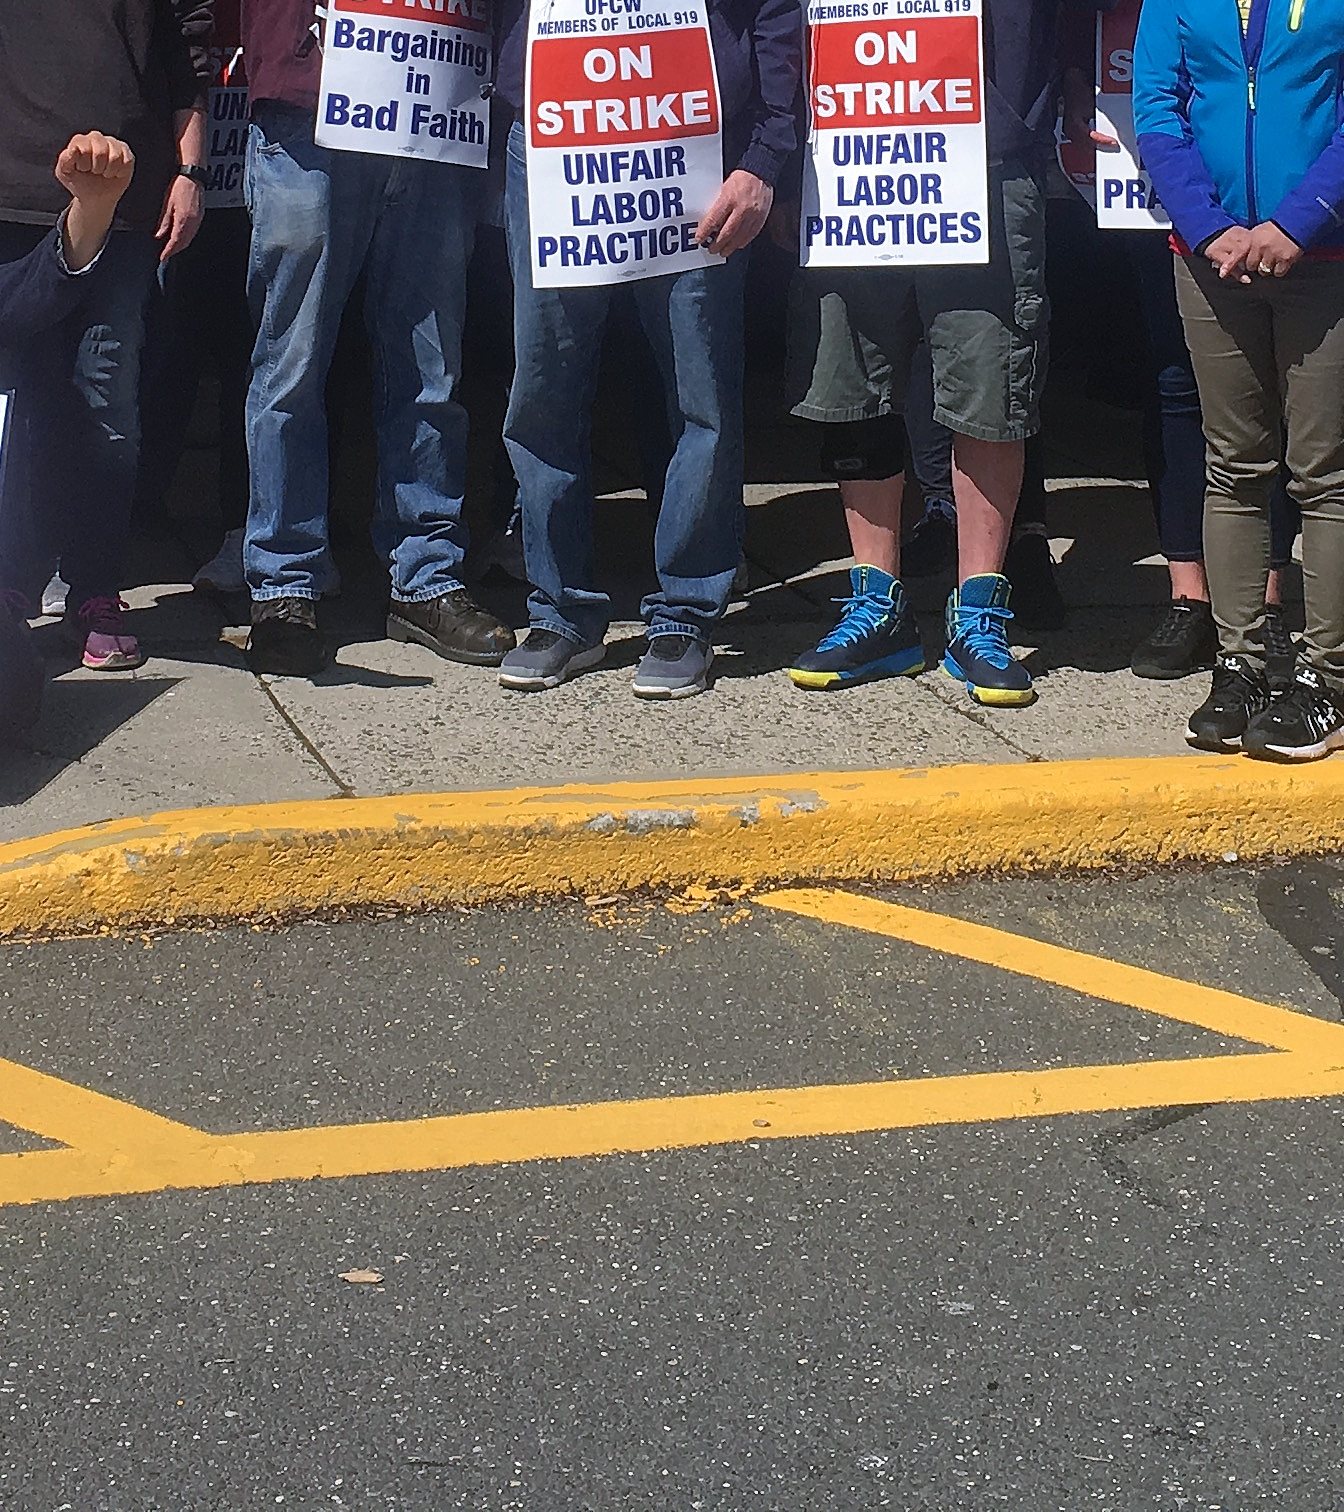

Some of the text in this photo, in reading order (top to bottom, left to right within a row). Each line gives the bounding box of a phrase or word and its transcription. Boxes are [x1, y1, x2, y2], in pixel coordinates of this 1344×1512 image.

[537, 10, 698, 35] MEMBERS OF LOCAL 919
[809, 3, 869, 21] MEMBERS
[872, 1, 889, 16] OF
[896, 0, 941, 14] LOCAL
[333, 18, 488, 76] Bargaining
[583, 45, 653, 83] ON
[854, 30, 918, 66] ON
[406, 66, 431, 95] in
[814, 78, 974, 118] STRIKE
[325, 93, 485, 144] Bad Faith
[536, 89, 711, 136] STRIKE
[563, 145, 687, 186] UNFAIR
[832, 131, 947, 167] UNFAIR
[571, 187, 684, 227] LABOR
[836, 173, 943, 207] LABOR
[806, 211, 982, 248] PRACTICES
